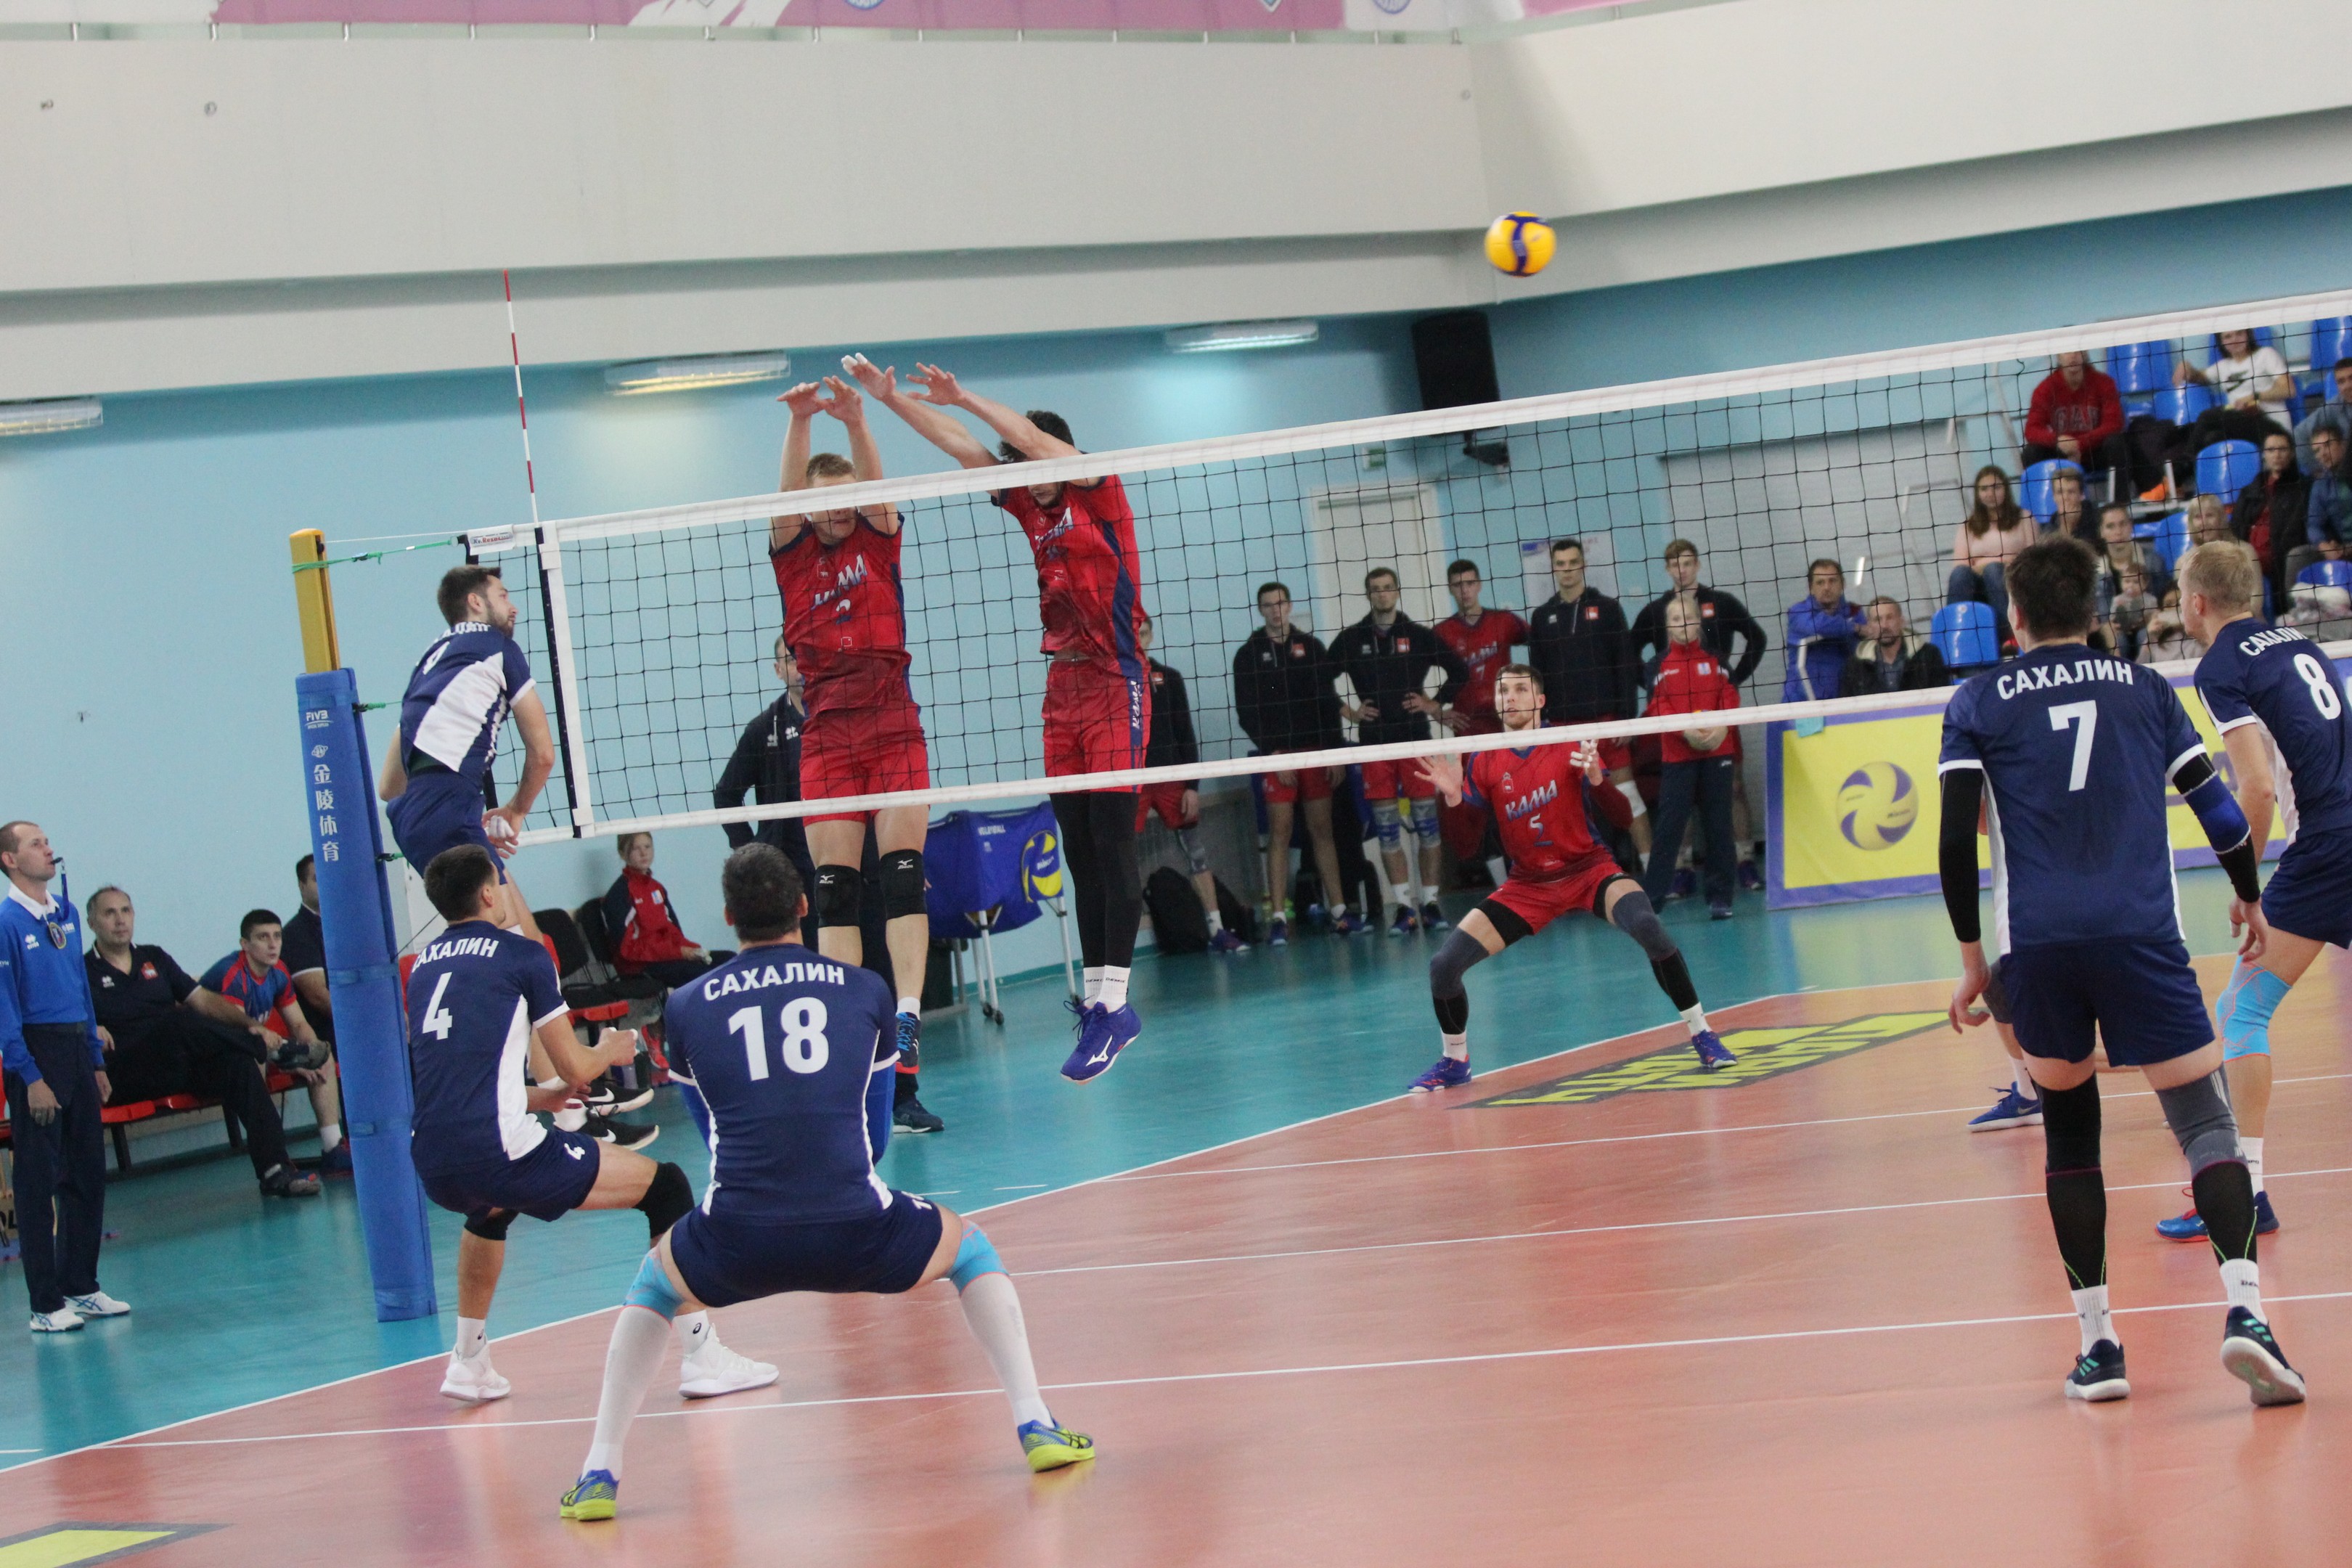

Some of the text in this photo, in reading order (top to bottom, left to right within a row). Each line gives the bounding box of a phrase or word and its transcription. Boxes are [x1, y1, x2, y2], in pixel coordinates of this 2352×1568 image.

[2240, 627, 2308, 656] САХАЛИ
[1997, 659, 2133, 700] САХАЛИН
[2294, 653, 2341, 720] 8
[306, 710, 328, 721] FIVB
[2048, 700, 2097, 791] 7
[314, 764, 340, 862] 金陵体育
[1505, 779, 1558, 822] КАМА
[1530, 813, 1545, 840] 5
[704, 963, 845, 1001] САХАЛИН
[422, 972, 453, 1040] 4
[728, 997, 829, 1081] 18
